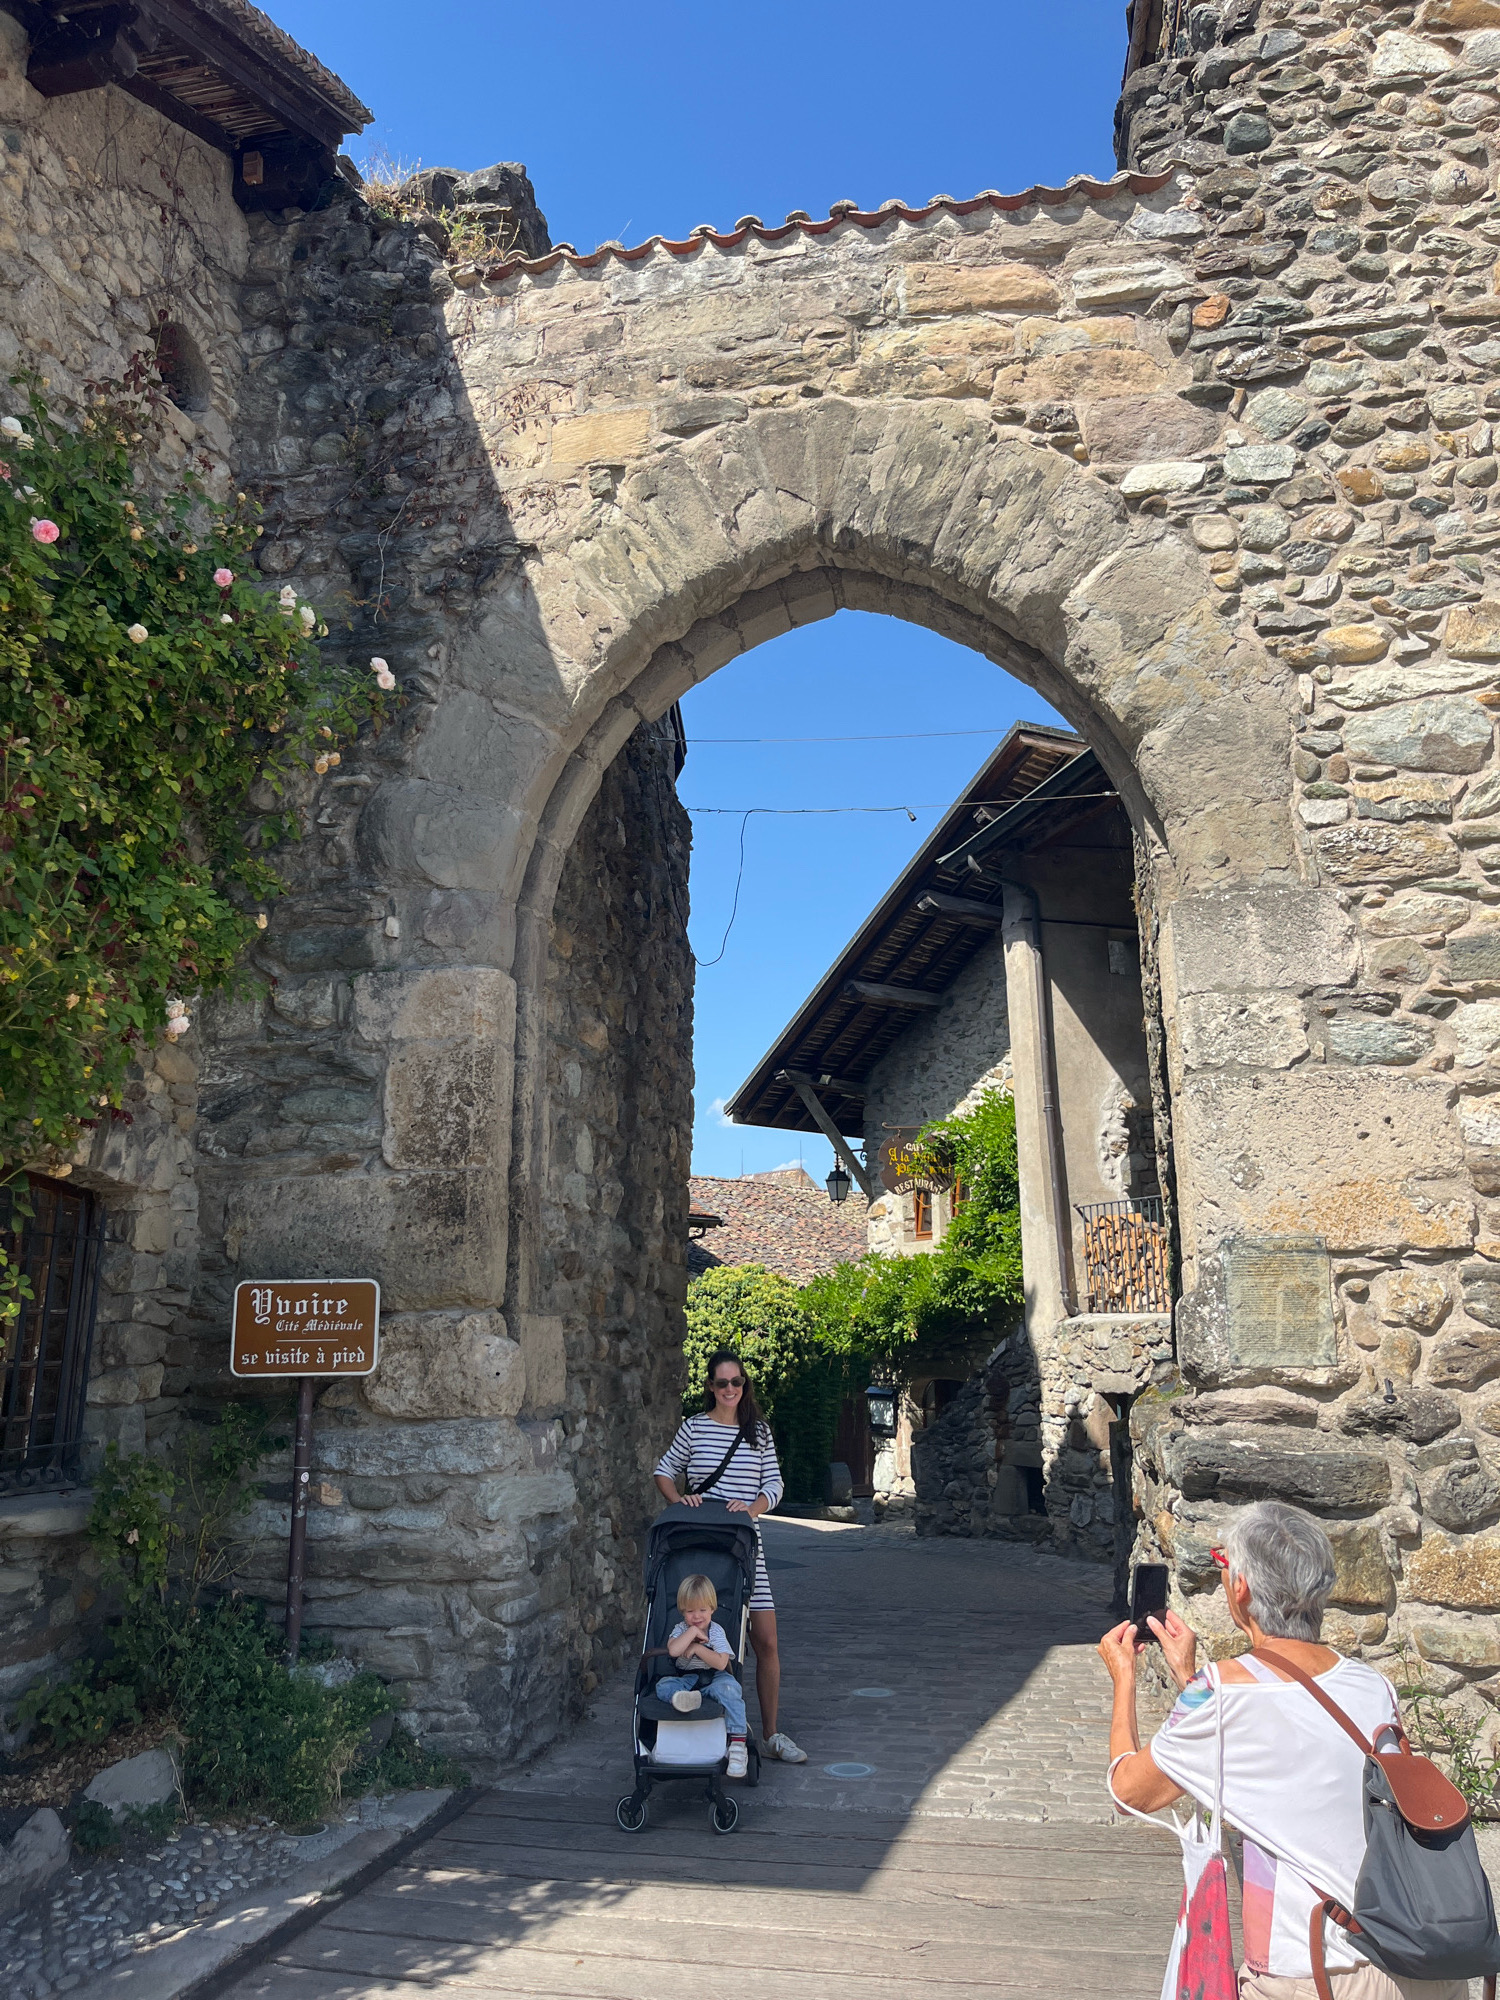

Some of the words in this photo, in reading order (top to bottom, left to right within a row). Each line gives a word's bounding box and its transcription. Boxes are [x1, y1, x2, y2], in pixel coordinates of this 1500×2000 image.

[900, 1150, 910, 1162] la
[250, 1288, 349, 1325] Yvoire
[276, 1319, 299, 1332] Cité
[302, 1319, 364, 1334] Médiévale
[241, 1352, 259, 1365] se
[265, 1346, 310, 1365] visite
[316, 1347, 326, 1364] à
[332, 1345, 365, 1370] pied
